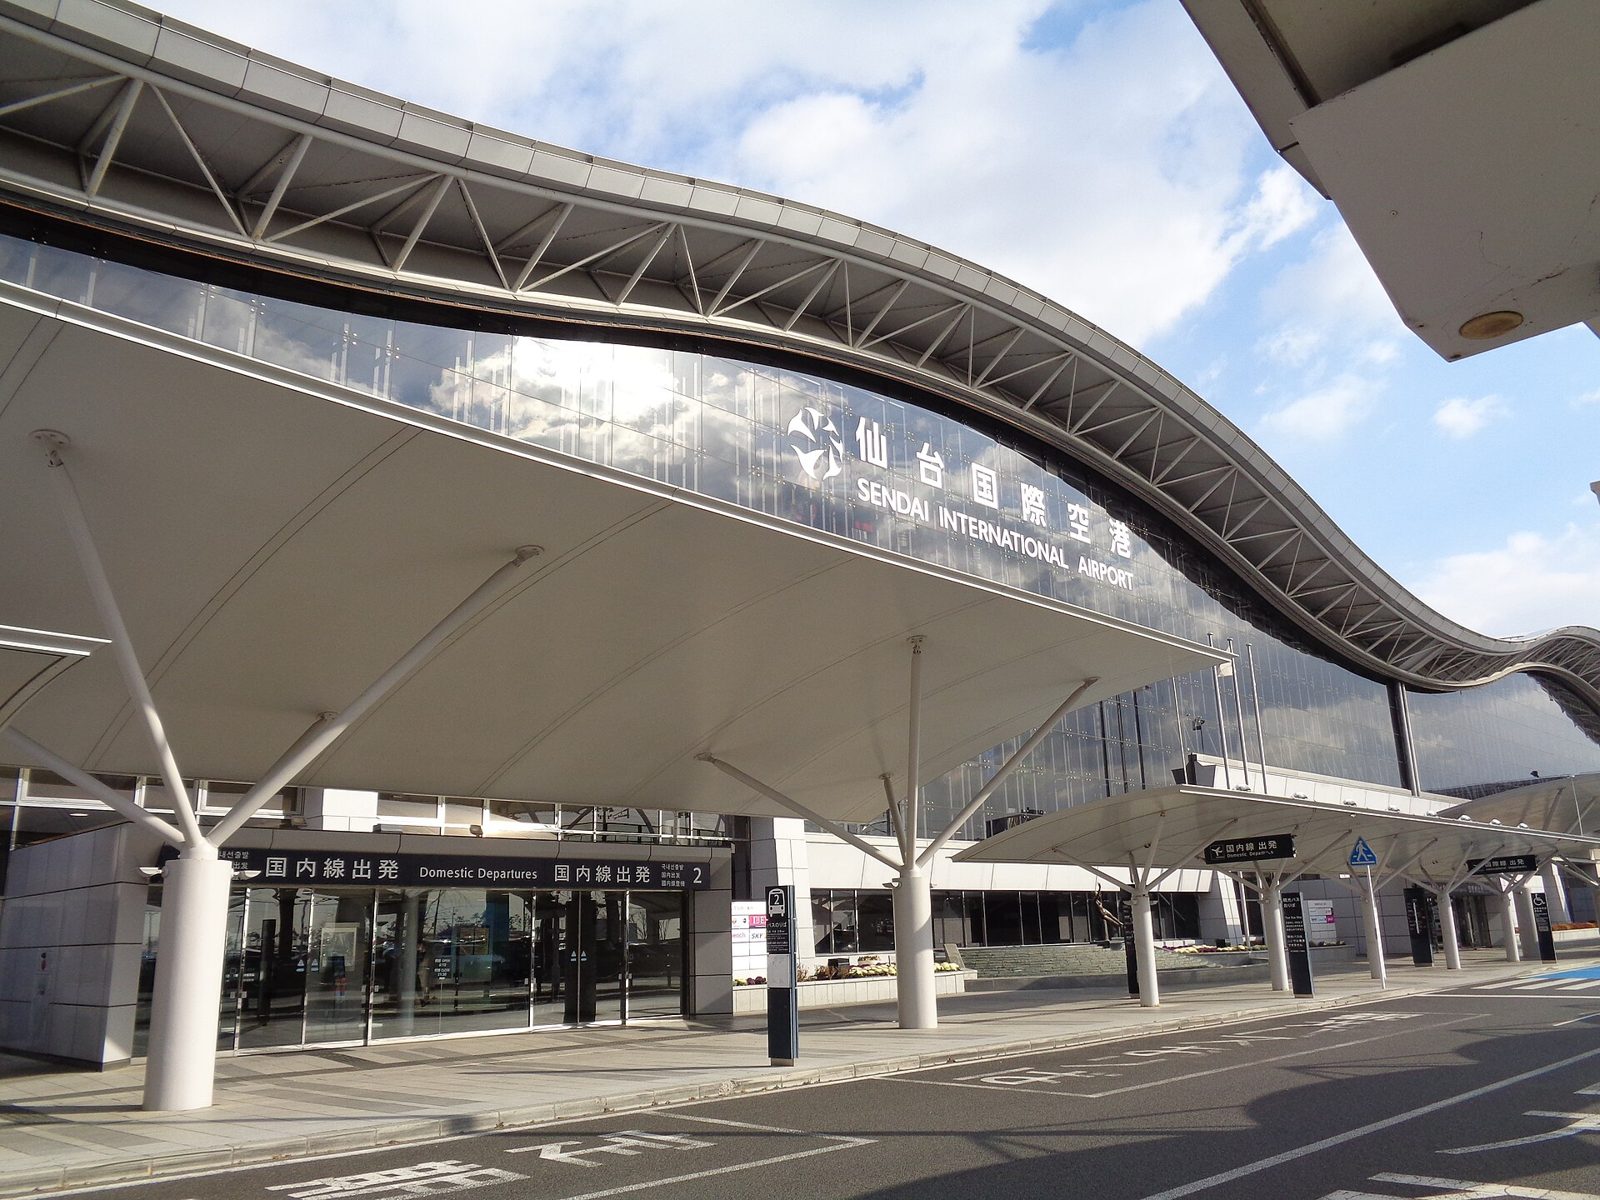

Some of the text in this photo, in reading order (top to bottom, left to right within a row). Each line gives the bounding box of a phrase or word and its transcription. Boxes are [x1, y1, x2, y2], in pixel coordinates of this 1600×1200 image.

[856, 417, 1131, 559] 仙台国際空港
[857, 477, 1134, 590] SENDAI INTERNATIONAL AIRPORT
[219, 851, 249, 859] 내선출발
[265, 857, 399, 880] 国内線出発
[419, 866, 538, 881] Domestic Departures
[554, 864, 651, 883] 国内線出発
[693, 867, 702, 884] 2
[774, 894, 780, 905] 2
